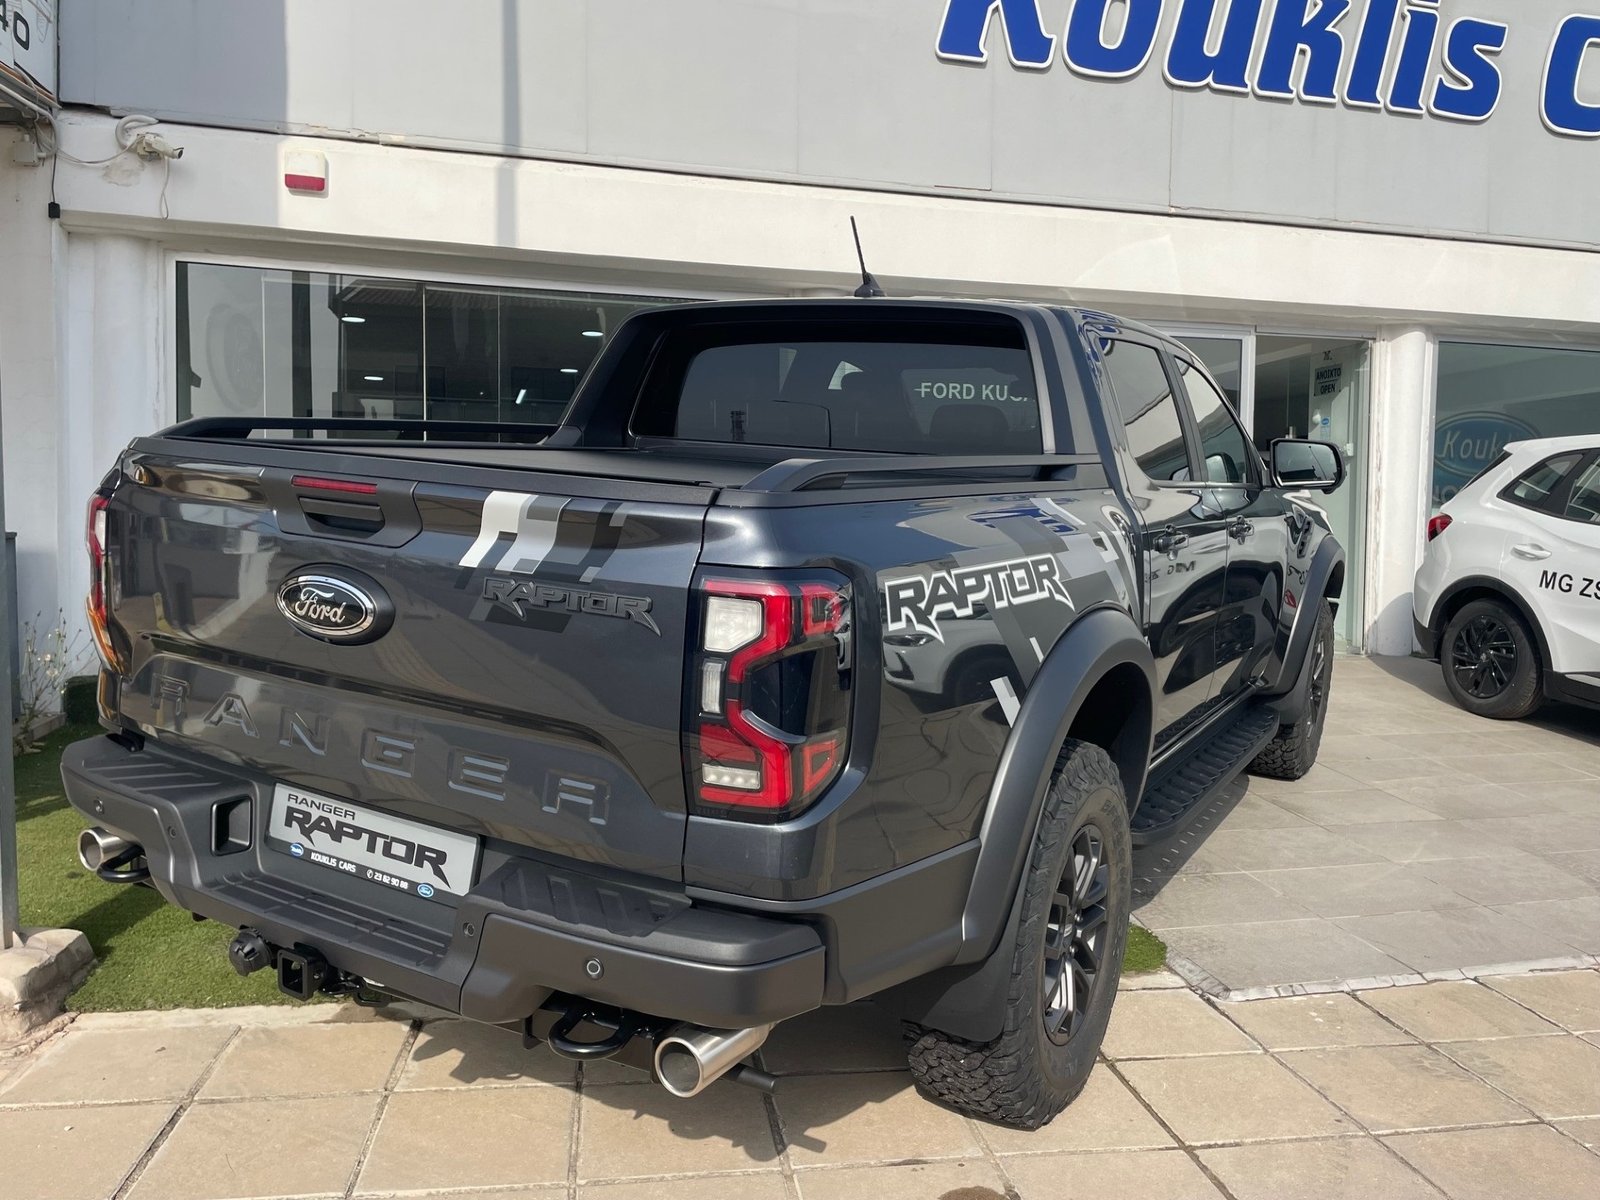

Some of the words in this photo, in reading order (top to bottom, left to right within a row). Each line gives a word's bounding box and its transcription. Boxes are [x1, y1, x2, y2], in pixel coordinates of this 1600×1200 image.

[920, 382, 976, 400] FORD
[981, 384, 1028, 401] KU
[1320, 383, 1336, 394] OPEN
[1539, 569, 1574, 593] MG
[295, 587, 347, 623] Ford
[483, 576, 662, 638] RAPTOR
[883, 553, 1076, 645] RAPTOR
[149, 672, 611, 826] RANGER
[287, 793, 356, 821] RANGER
[284, 805, 452, 889] RAPTOR
[338, 860, 357, 873] CARS
